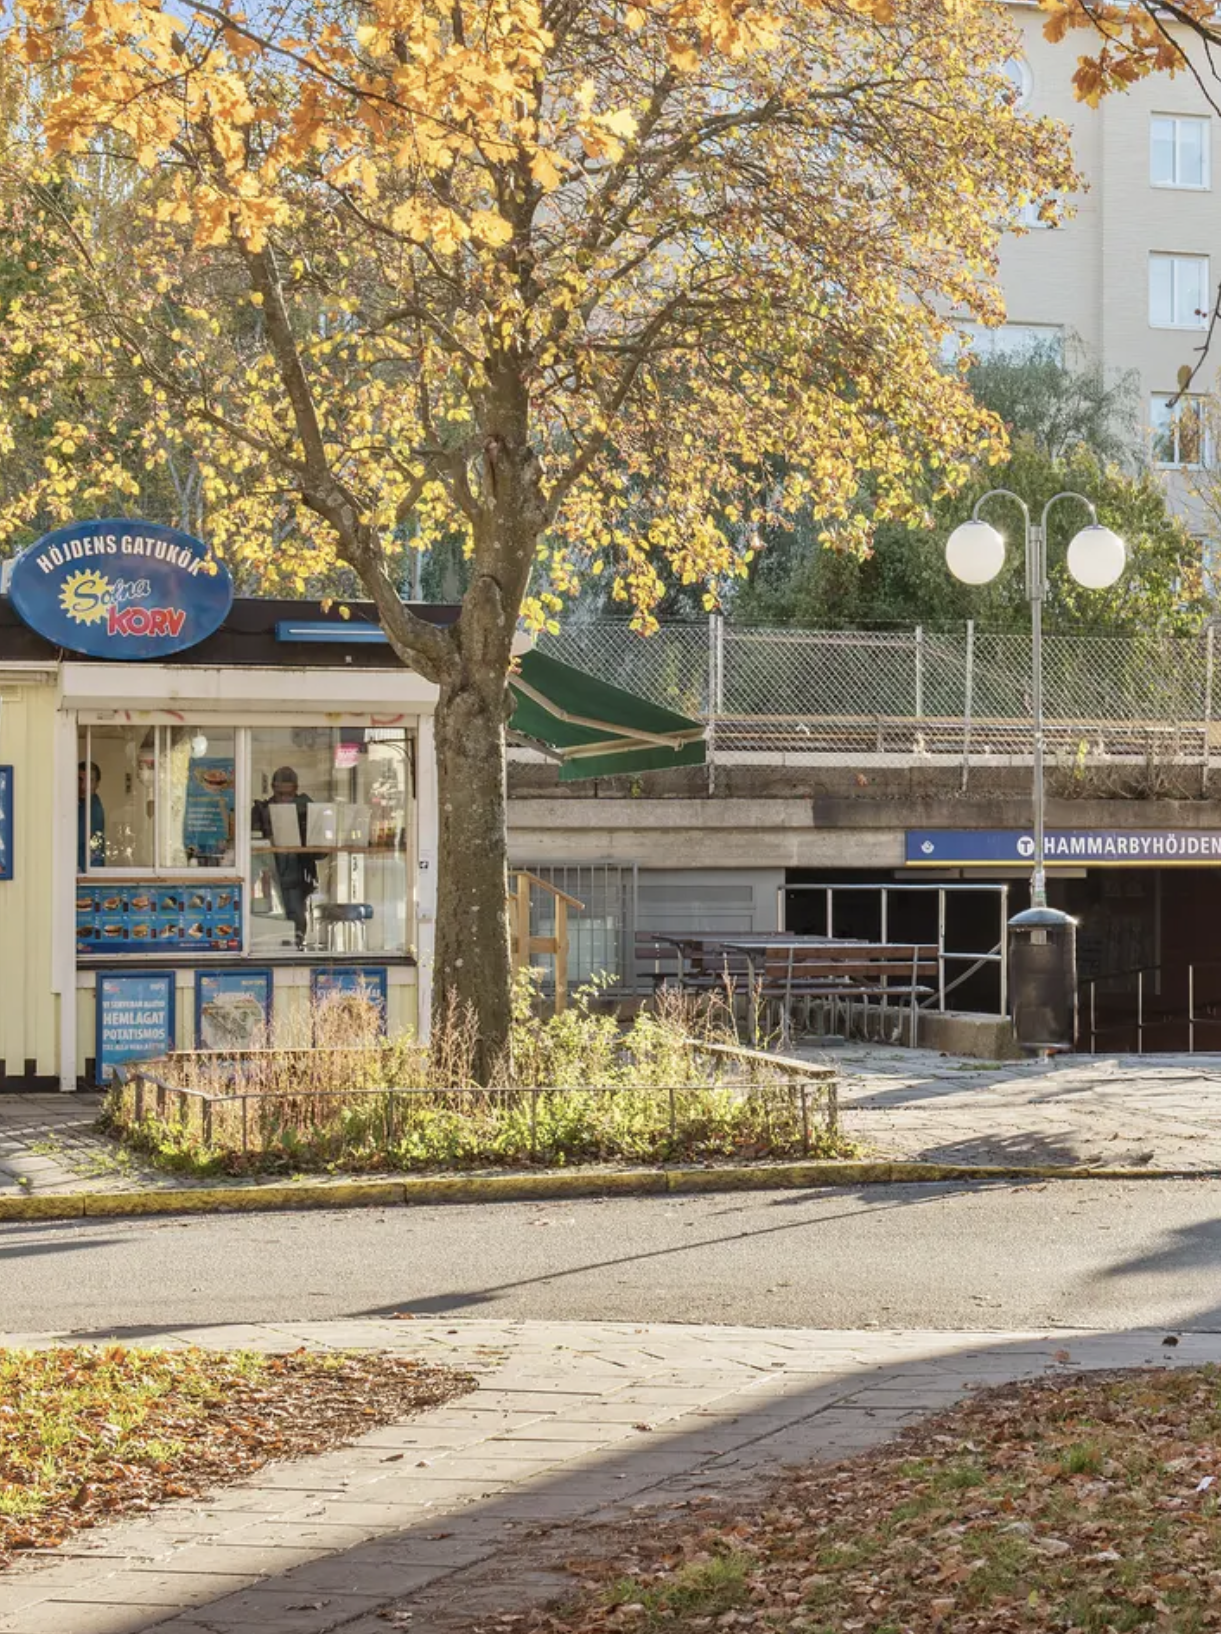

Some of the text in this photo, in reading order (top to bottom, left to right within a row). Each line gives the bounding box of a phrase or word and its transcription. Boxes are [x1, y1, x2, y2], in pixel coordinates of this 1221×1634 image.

[36, 534, 117, 574] HÖJDENS
[72, 579, 151, 613] Solna
[107, 606, 186, 637] KORV
[103, 1012, 165, 1024] HEMLAGAT
[103, 1029, 165, 1040] POTATISMOS
